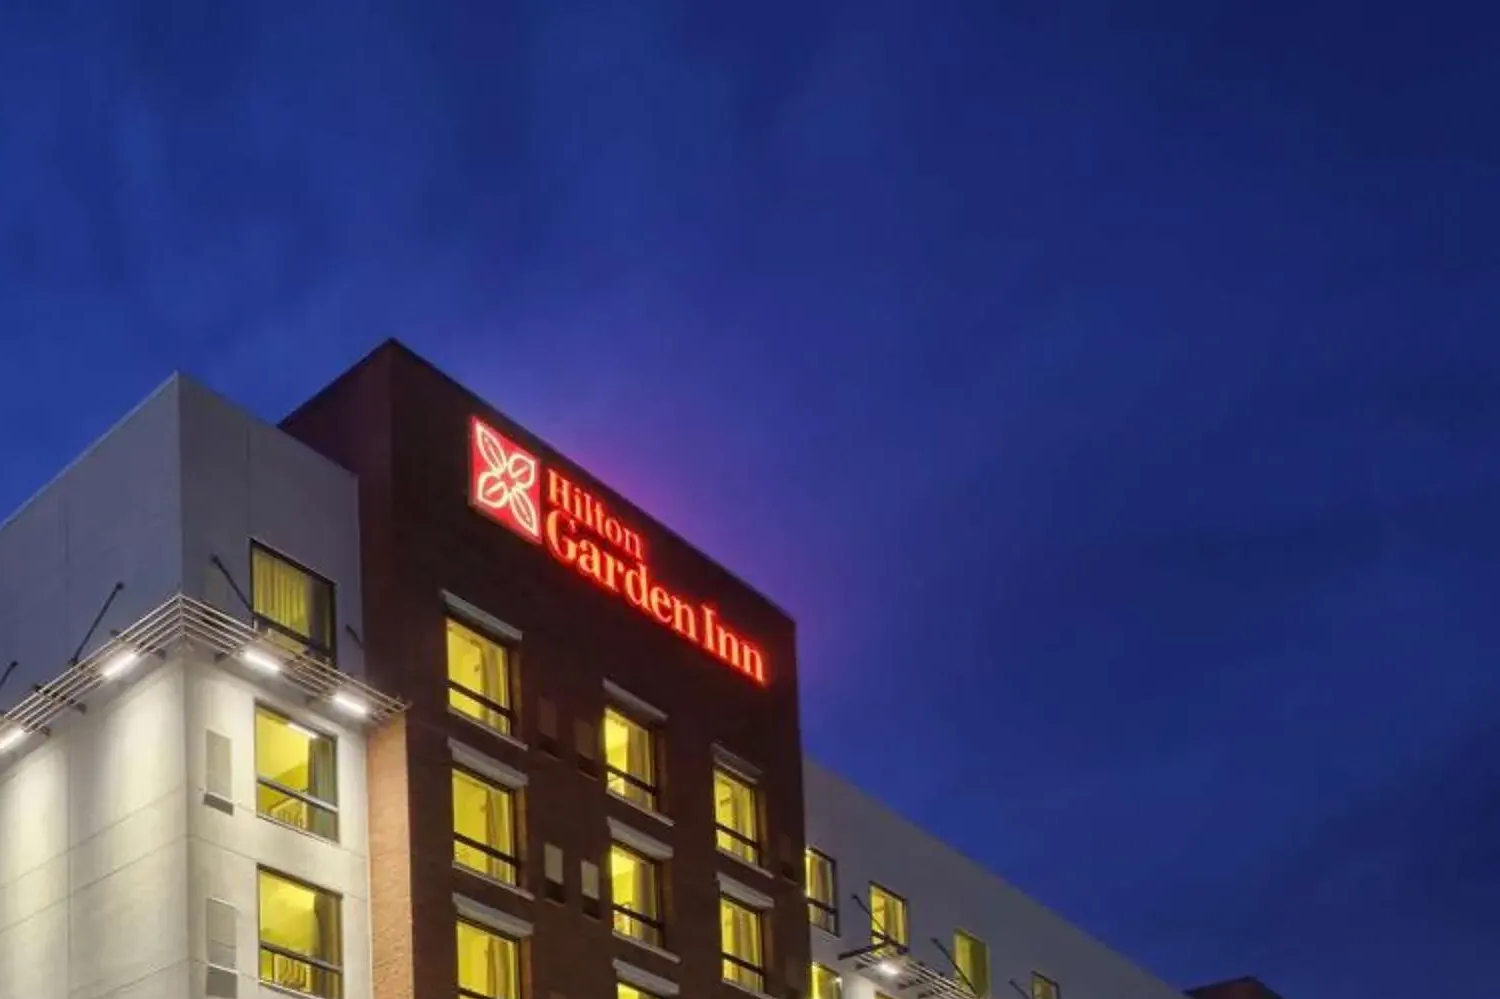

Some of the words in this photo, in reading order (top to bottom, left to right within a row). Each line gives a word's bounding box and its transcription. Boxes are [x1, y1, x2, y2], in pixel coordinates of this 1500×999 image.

[547, 467, 643, 560] Hilton
[546, 508, 699, 643] Garden
[702, 602, 766, 687] Inn
